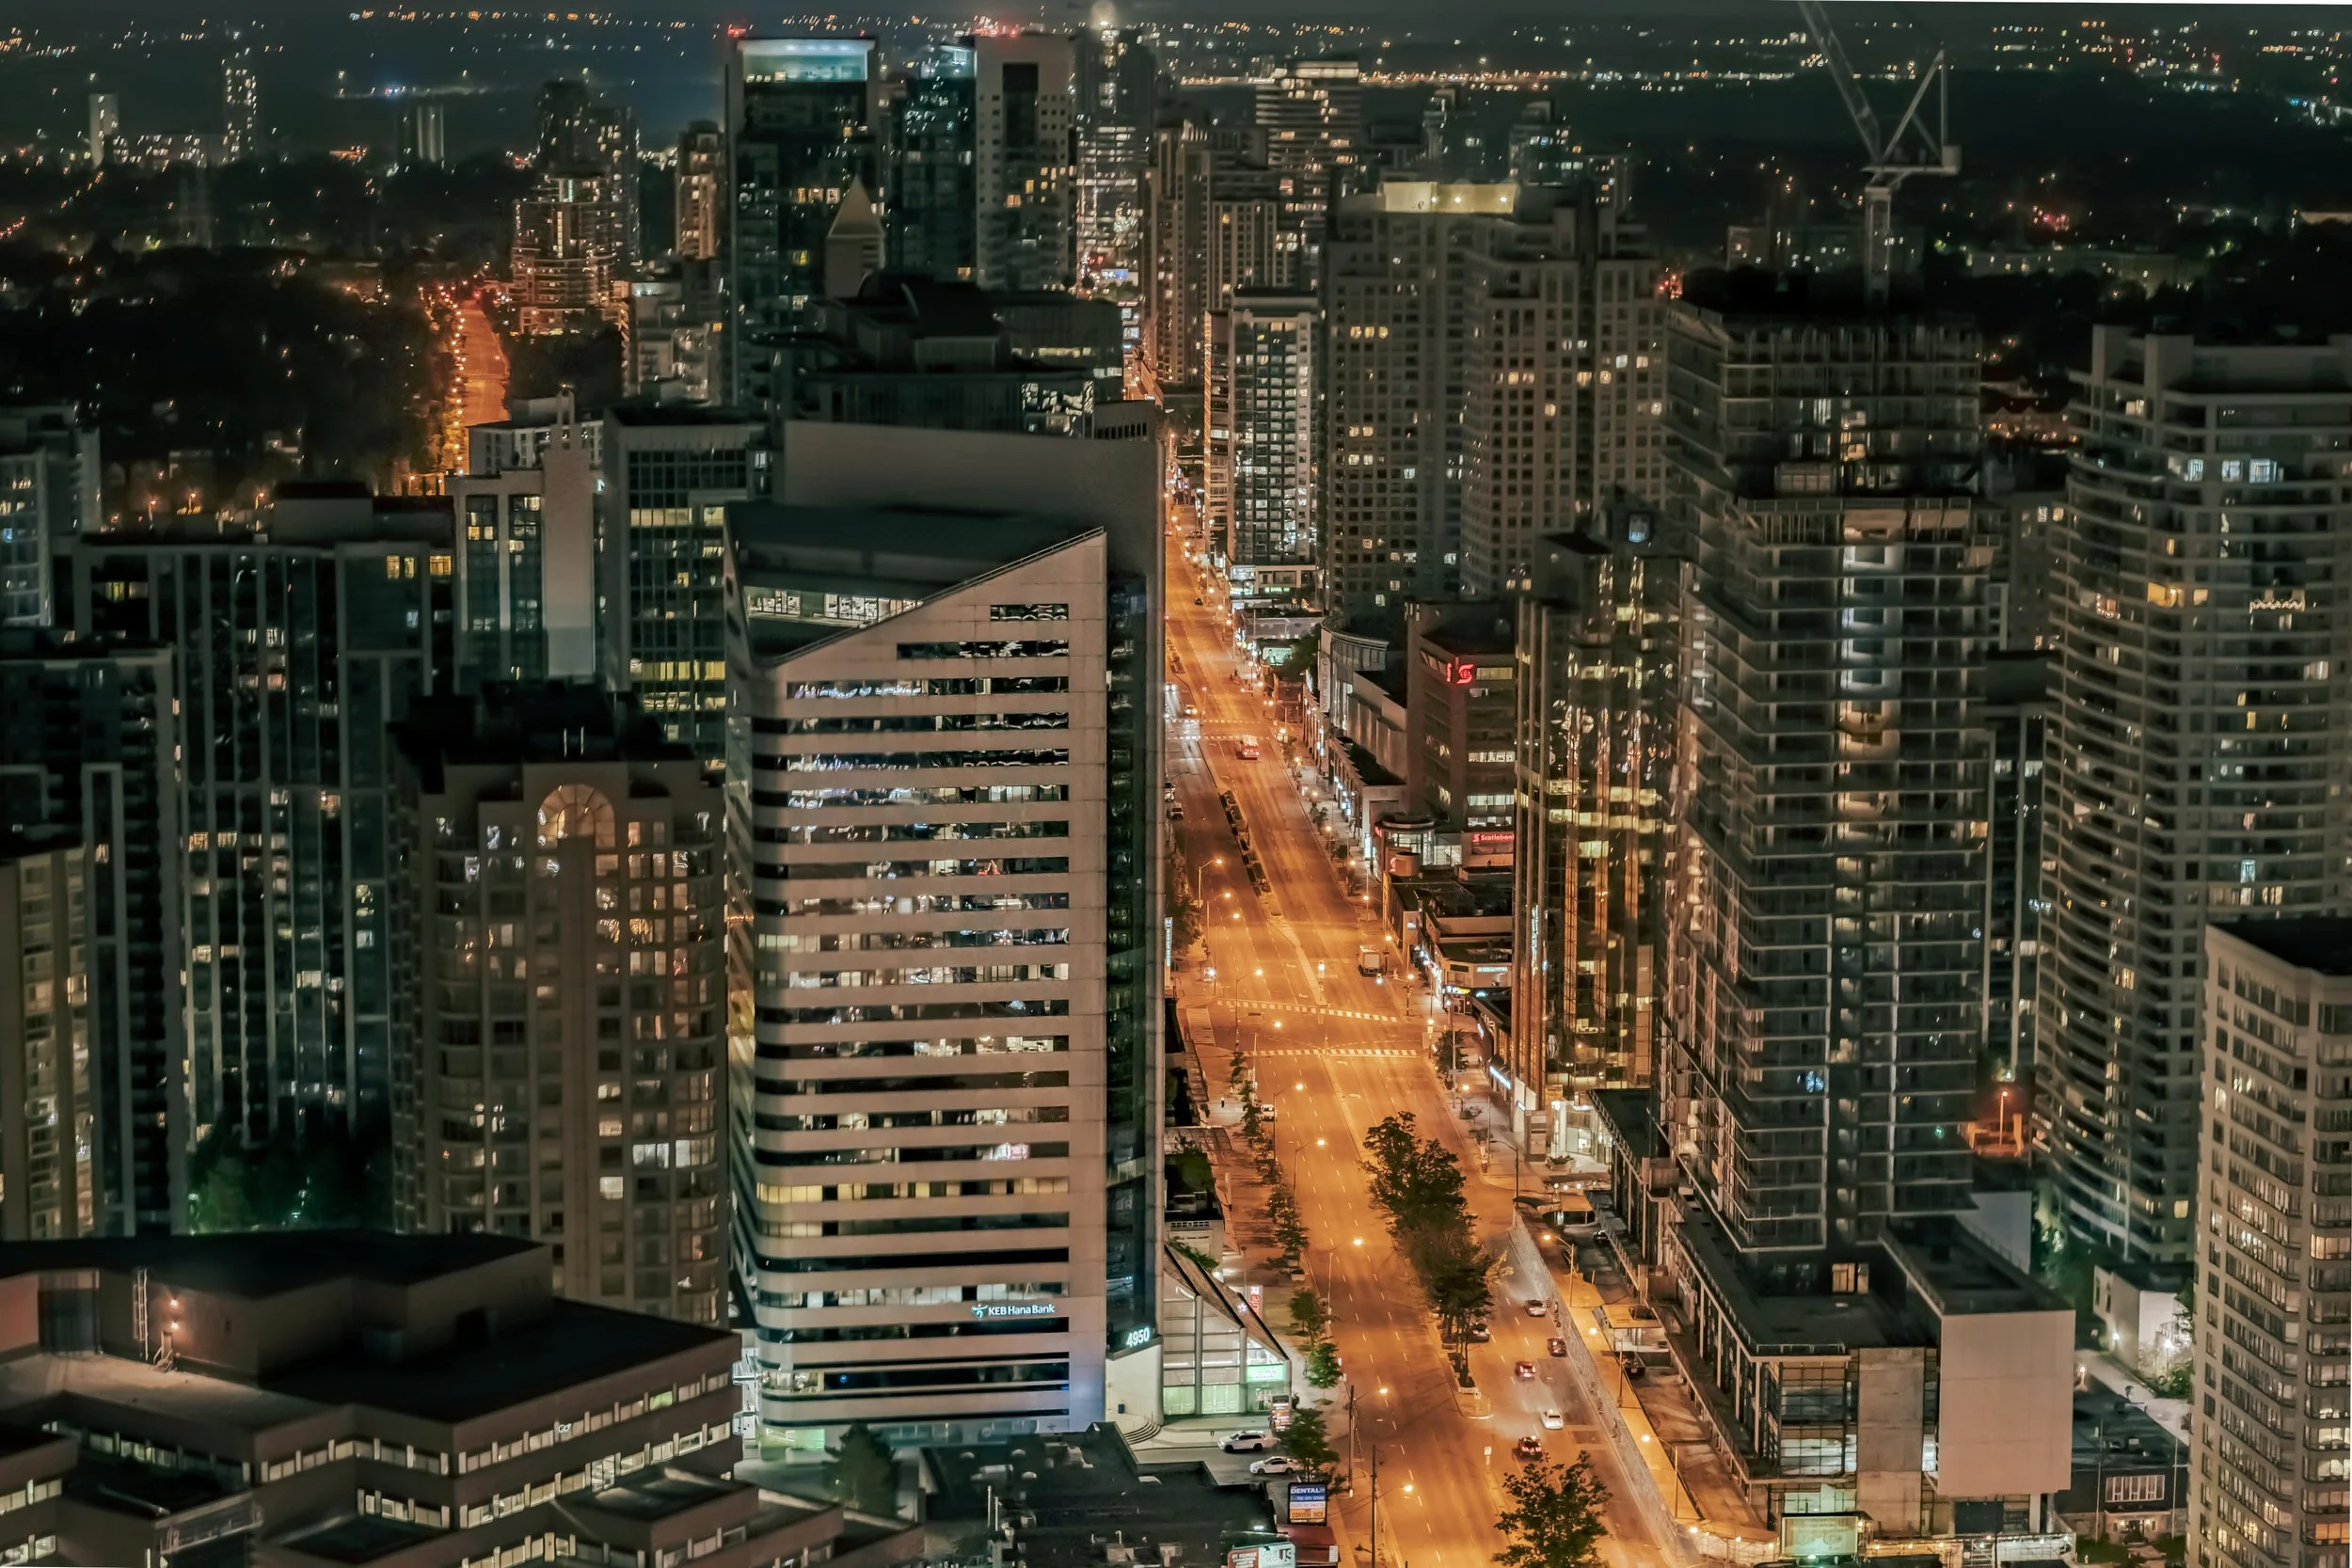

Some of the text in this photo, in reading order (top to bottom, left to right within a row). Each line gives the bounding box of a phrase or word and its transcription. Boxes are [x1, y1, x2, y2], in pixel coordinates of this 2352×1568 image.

[988, 1304, 1055, 1316] KEB Hana Bank
[1126, 1327, 1150, 1347] 4950
